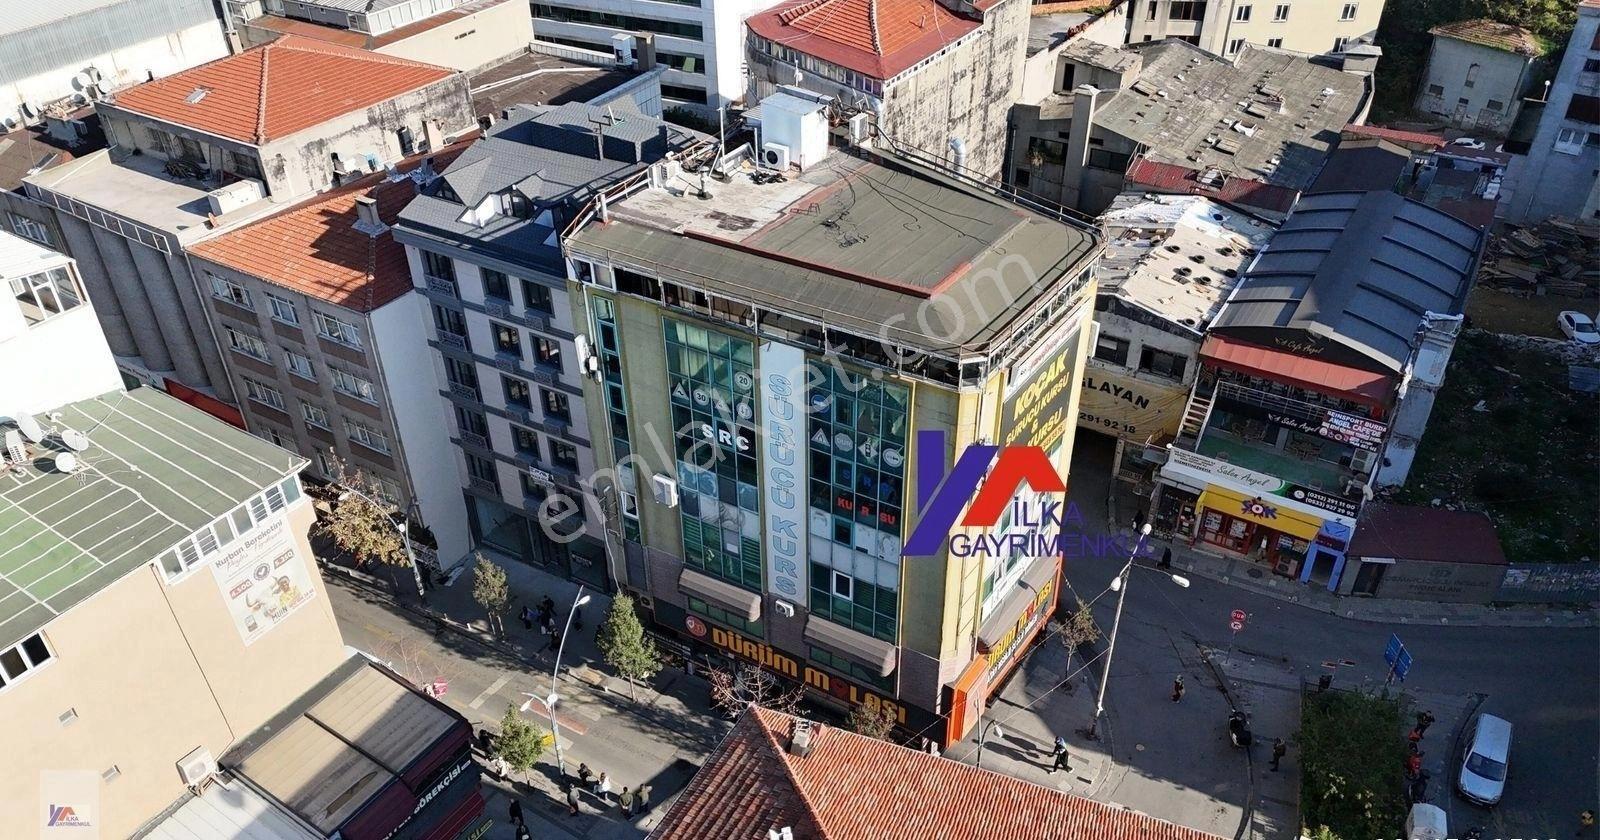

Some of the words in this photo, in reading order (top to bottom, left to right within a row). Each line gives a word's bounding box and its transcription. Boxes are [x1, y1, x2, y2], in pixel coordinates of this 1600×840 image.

[1013, 348, 1069, 421] KOÇAK
[1082, 378, 1149, 409] LAYAN
[769, 373, 795, 510] SÜRÜCÜ
[1080, 412, 1099, 423] 291
[1104, 419, 1118, 429] 92
[1123, 424, 1136, 434] 18
[1329, 417, 1351, 429] ANGEL
[214, 546, 244, 568] Kurban
[771, 514, 798, 596] KURS
[712, 627, 798, 677] DÜRÜM
